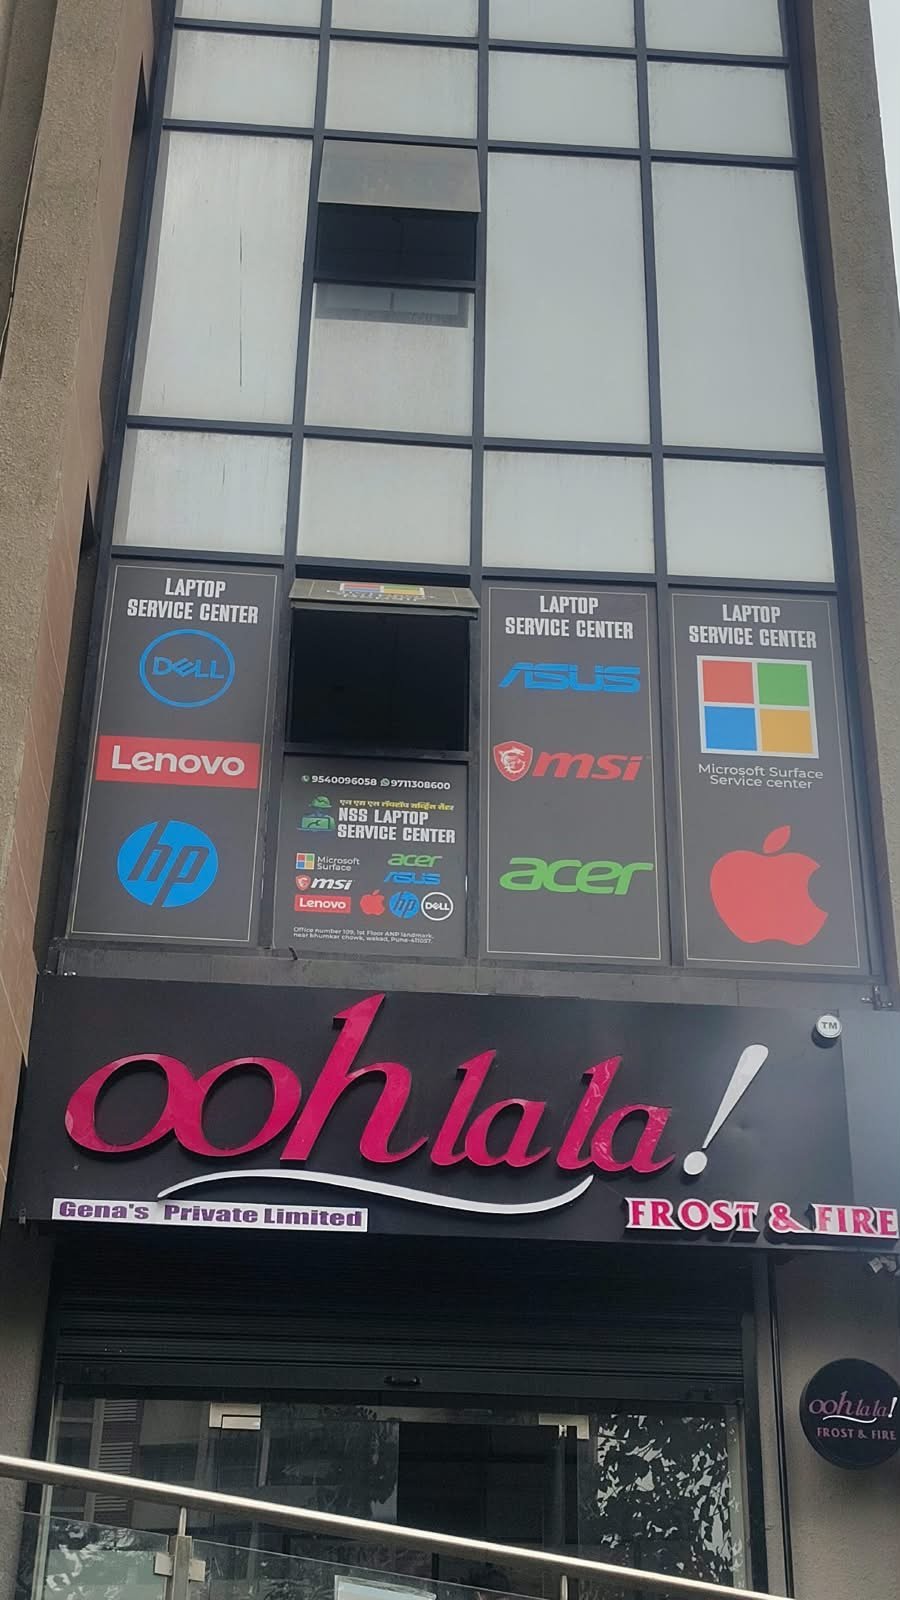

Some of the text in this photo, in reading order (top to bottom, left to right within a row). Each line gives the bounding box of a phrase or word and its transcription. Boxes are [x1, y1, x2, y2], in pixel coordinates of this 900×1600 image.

[165, 577, 226, 598] LAPTOP
[127, 599, 259, 624] SERVICE CENTER
[539, 595, 599, 615] LAPTOP
[722, 604, 781, 623] LAPTOP
[505, 617, 634, 640] SERVICE CENTER
[688, 625, 817, 649] SERVICE CENTER
[152, 656, 225, 680] DELL
[498, 662, 641, 694] ASUS
[111, 745, 245, 777] Lenovo
[531, 751, 642, 782] msi
[698, 763, 824, 779] Microsoft Surface
[311, 775, 451, 790] 9540096058 9711308600
[709, 774, 814, 790] Service center
[338, 807, 429, 826] NSS LAPTOP
[337, 823, 456, 844] SERVICE CENTER
[126, 821, 211, 907] hp
[316, 863, 352, 873] Surface
[317, 856, 360, 867] Microsoft
[387, 853, 443, 868] acer
[310, 878, 353, 891] msi
[384, 871, 441, 885] ASUS
[499, 857, 654, 896] acer
[299, 898, 347, 910] Lenovo
[425, 902, 450, 911] DELL
[820, 1021, 838, 1030] TM
[59, 1200, 362, 1227] Gena's Private Limited
[625, 1197, 899, 1238] FROST & FIRE
[816, 1427, 897, 1441] FROST & FIRE
